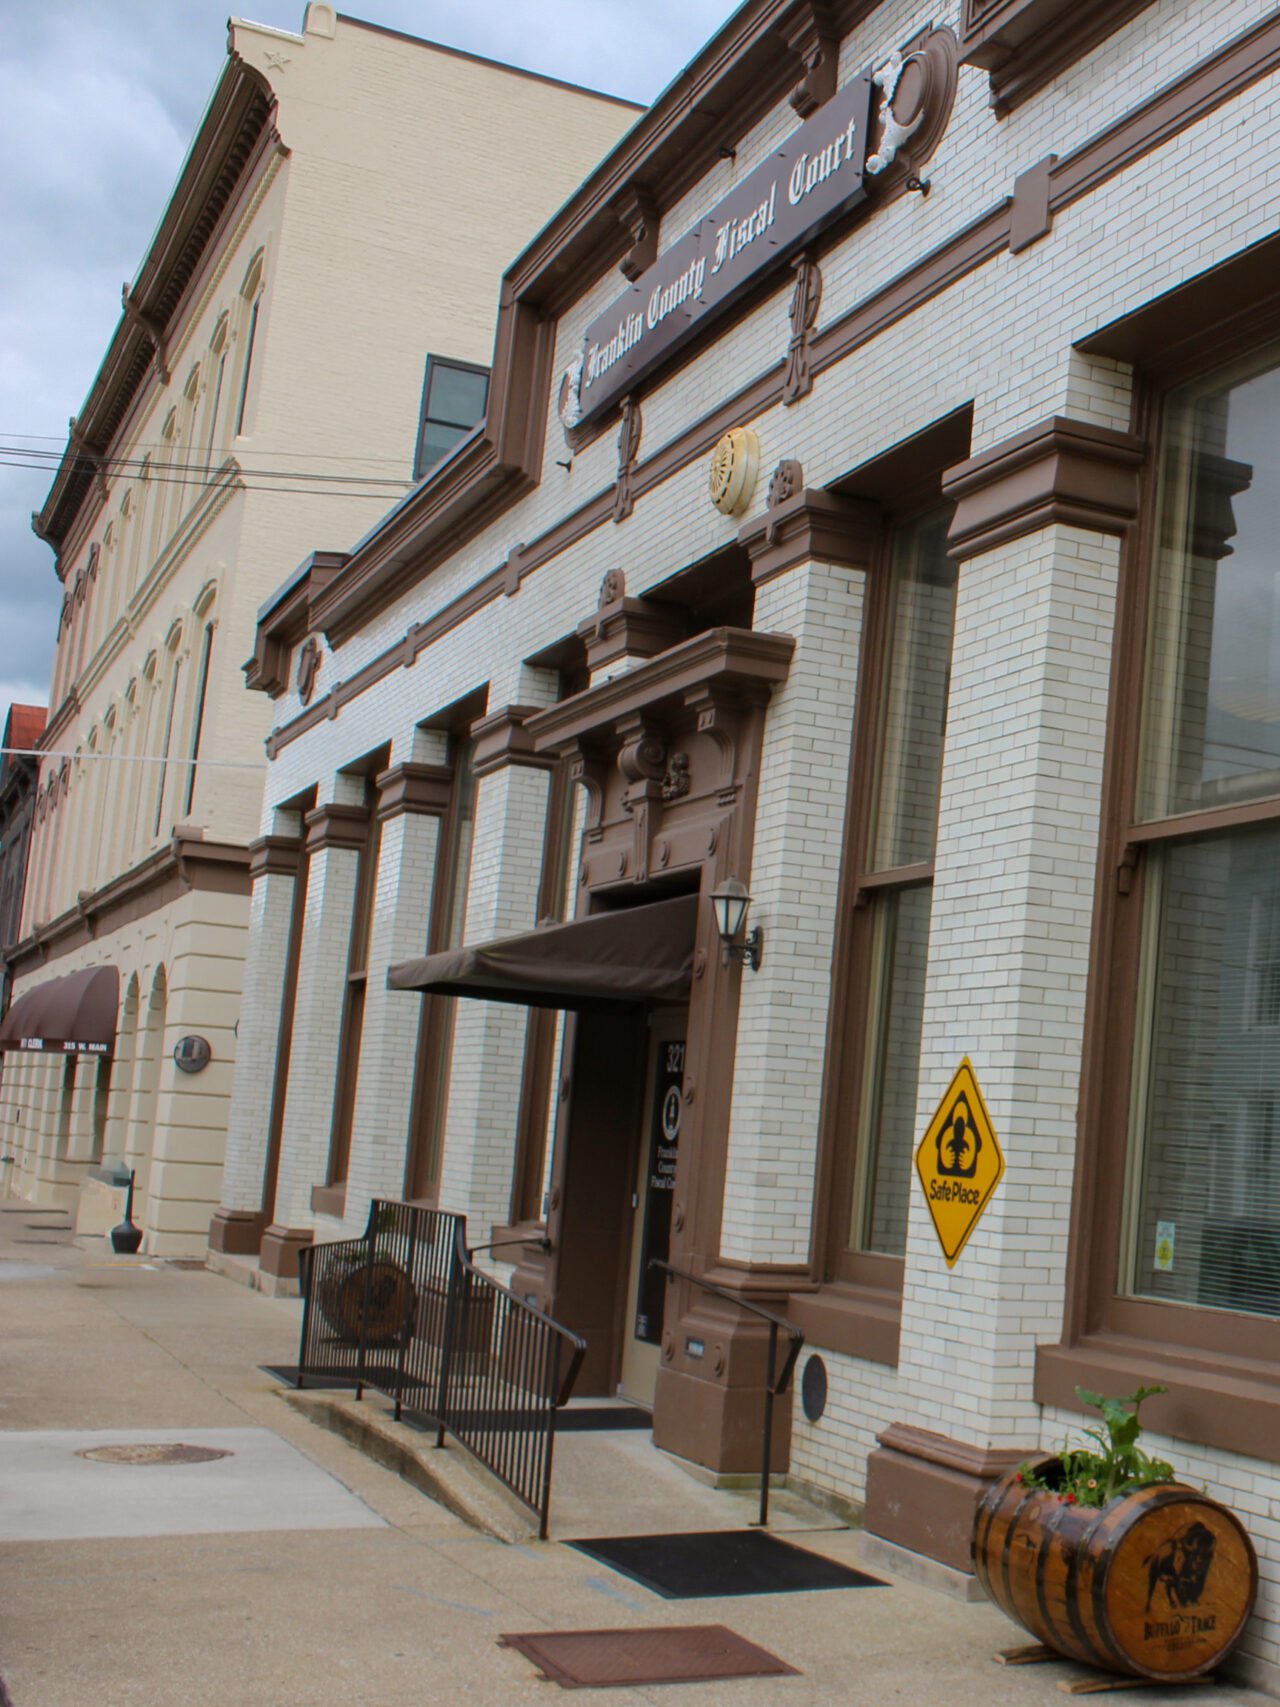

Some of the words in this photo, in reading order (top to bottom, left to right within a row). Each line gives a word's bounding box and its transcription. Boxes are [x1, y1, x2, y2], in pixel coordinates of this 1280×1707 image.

[585, 311, 644, 388] Franklin
[647, 254, 707, 330] County
[711, 181, 778, 276] Fiscal
[788, 117, 856, 206] Court
[666, 1044, 685, 1073] 321
[930, 1179, 951, 1202] Safe
[952, 1182, 980, 1206] Place
